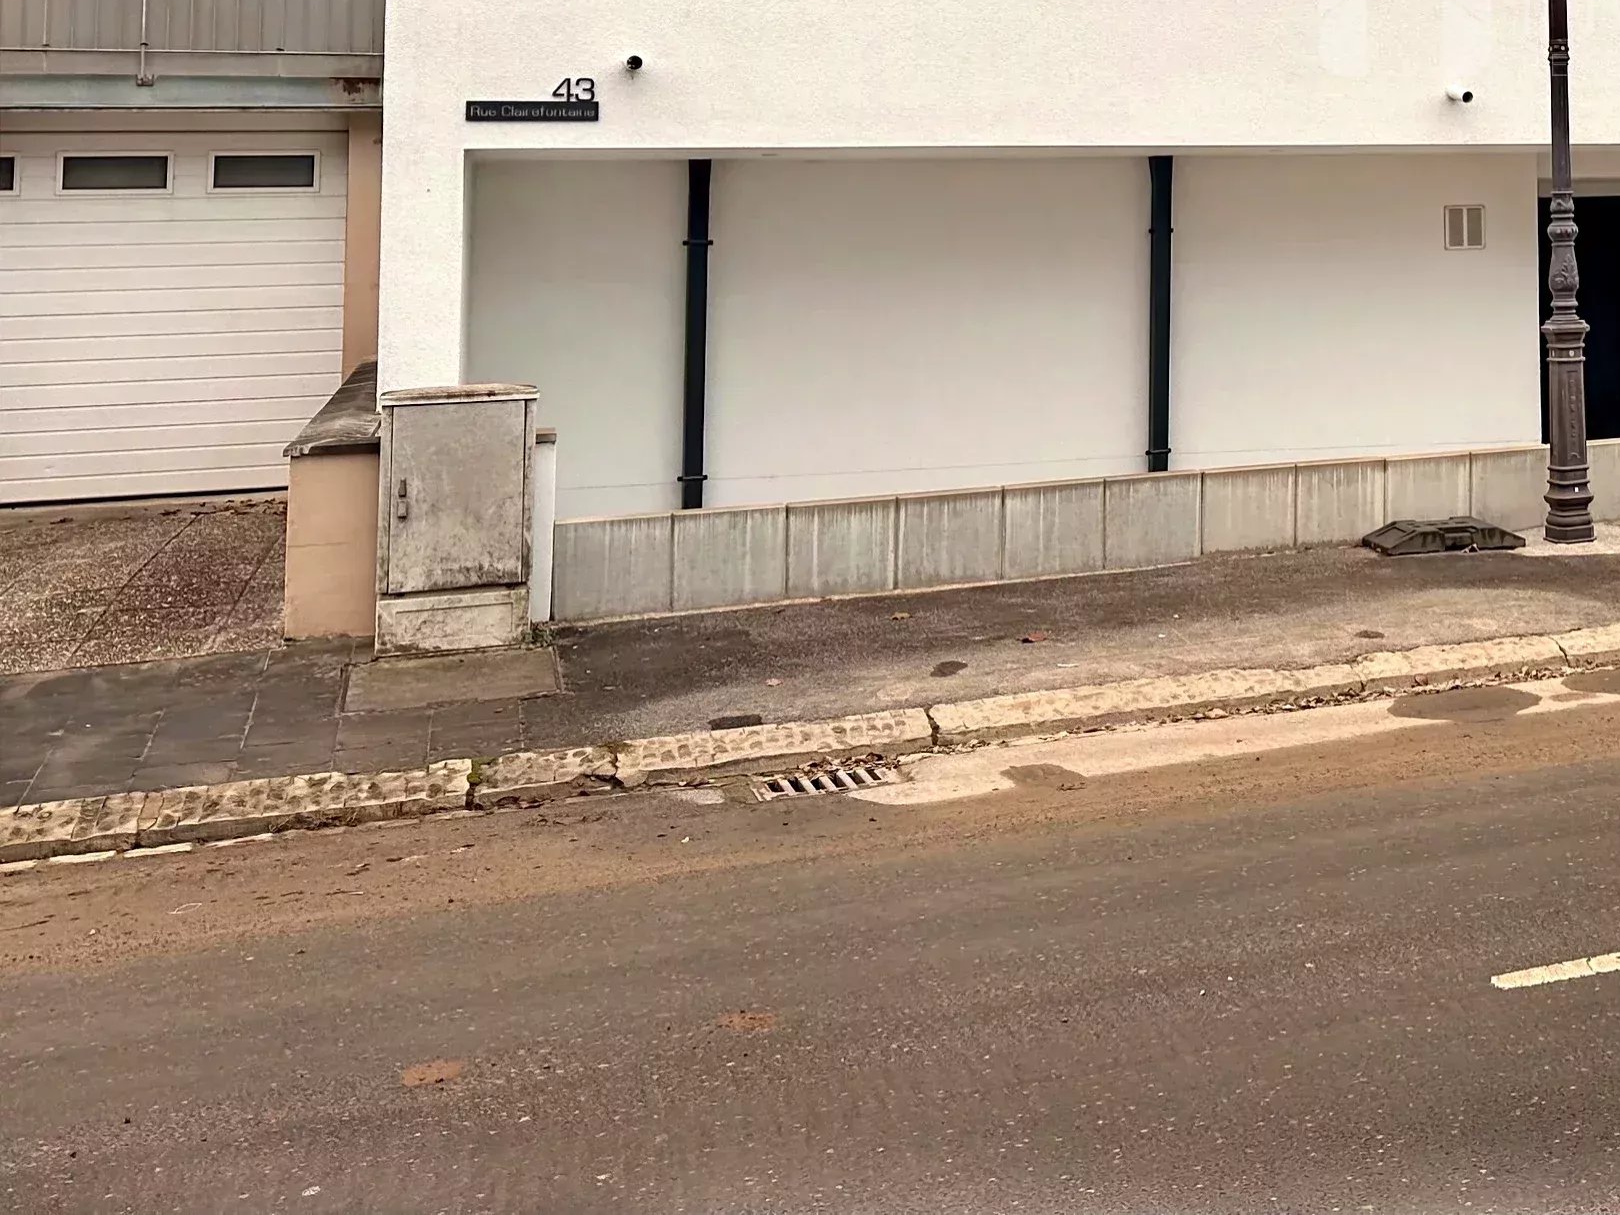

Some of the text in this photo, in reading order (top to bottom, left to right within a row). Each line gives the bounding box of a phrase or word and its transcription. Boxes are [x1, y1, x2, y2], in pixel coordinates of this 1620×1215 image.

[552, 77, 595, 102] 43
[470, 105, 595, 117] Rue Clairefontaine
